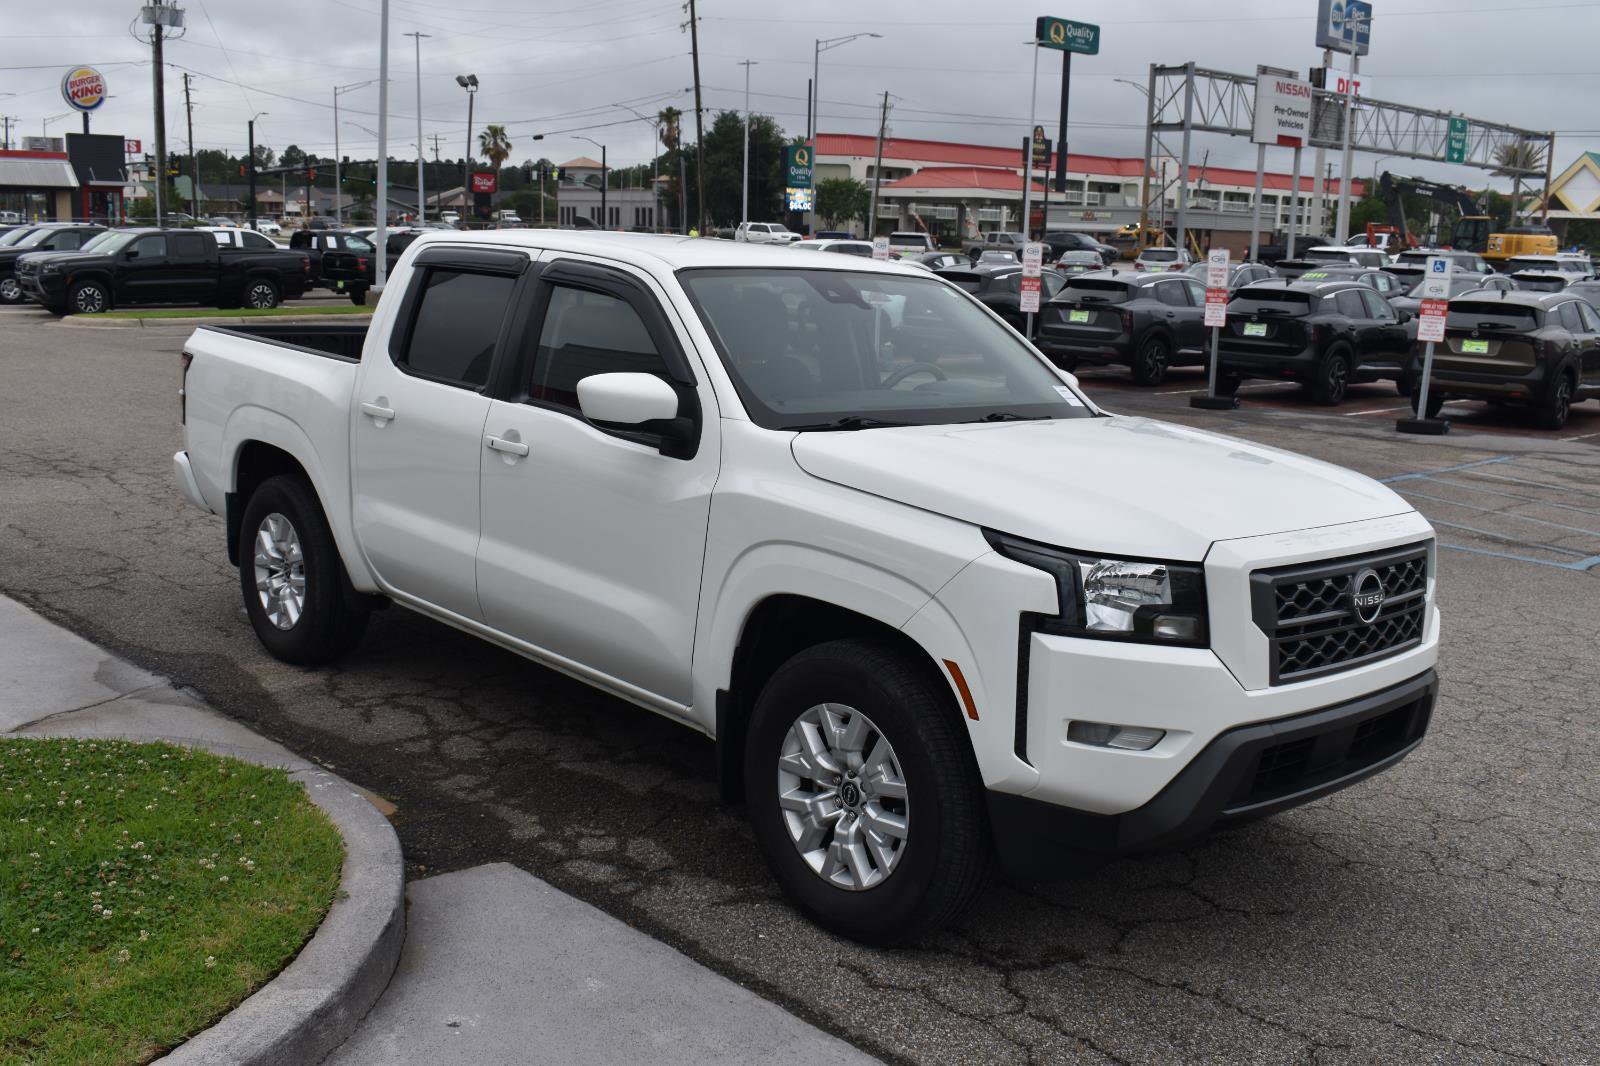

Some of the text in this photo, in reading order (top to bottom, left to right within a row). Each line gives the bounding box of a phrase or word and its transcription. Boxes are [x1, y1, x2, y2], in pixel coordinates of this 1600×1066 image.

[1352, 7, 1365, 19] Best
[1066, 24, 1094, 42] Quality
[69, 75, 101, 89] BURGER
[71, 84, 103, 100] KING
[1275, 81, 1311, 98] NISSAN
[1274, 105, 1309, 119] Pre-Owned
[1277, 118, 1304, 130] Vehicles
[790, 166, 812, 177] Quality
